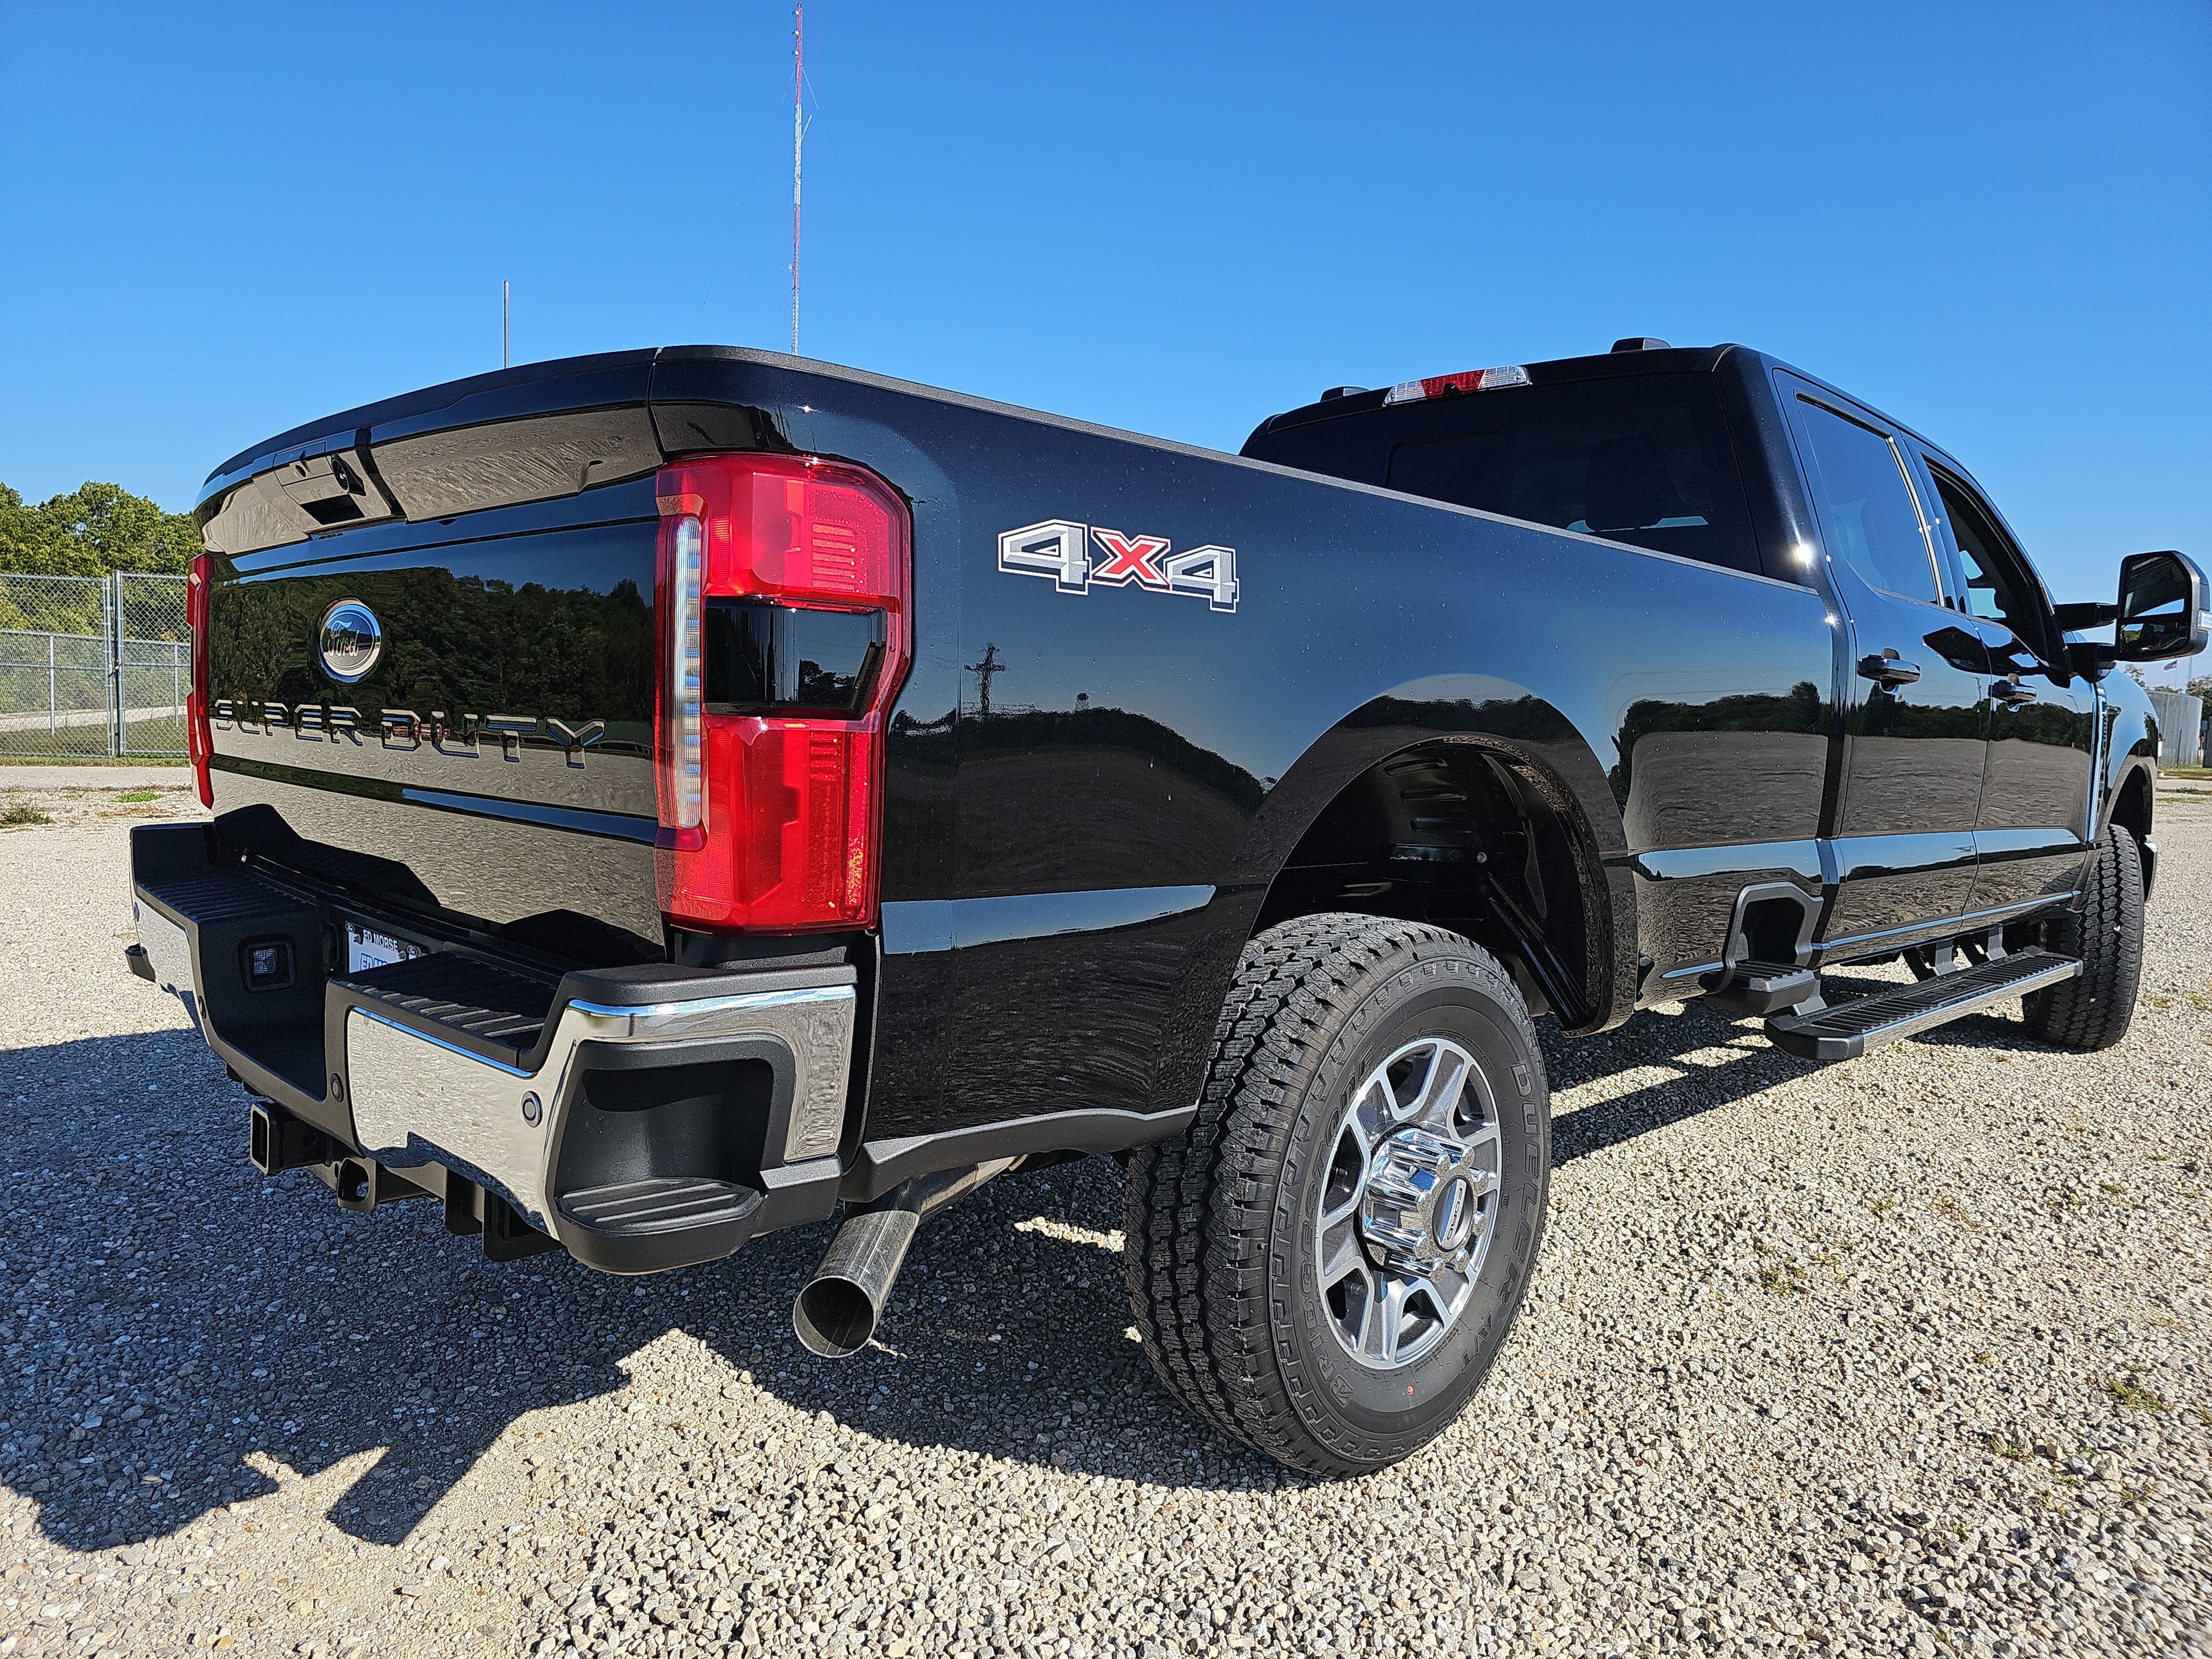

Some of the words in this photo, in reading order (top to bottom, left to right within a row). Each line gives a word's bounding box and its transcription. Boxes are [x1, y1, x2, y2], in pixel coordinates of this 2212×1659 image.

[327, 620, 359, 657] Ford
[214, 699, 364, 747] SUPER
[380, 709, 606, 769] DUTY
[363, 929, 372, 943] ED
[373, 933, 398, 953] MORSE
[1446, 1187, 1463, 1241] FORD
[1500, 1060, 1541, 1306] DUELER
[1300, 1041, 1375, 1409] BRIDGESTONE
